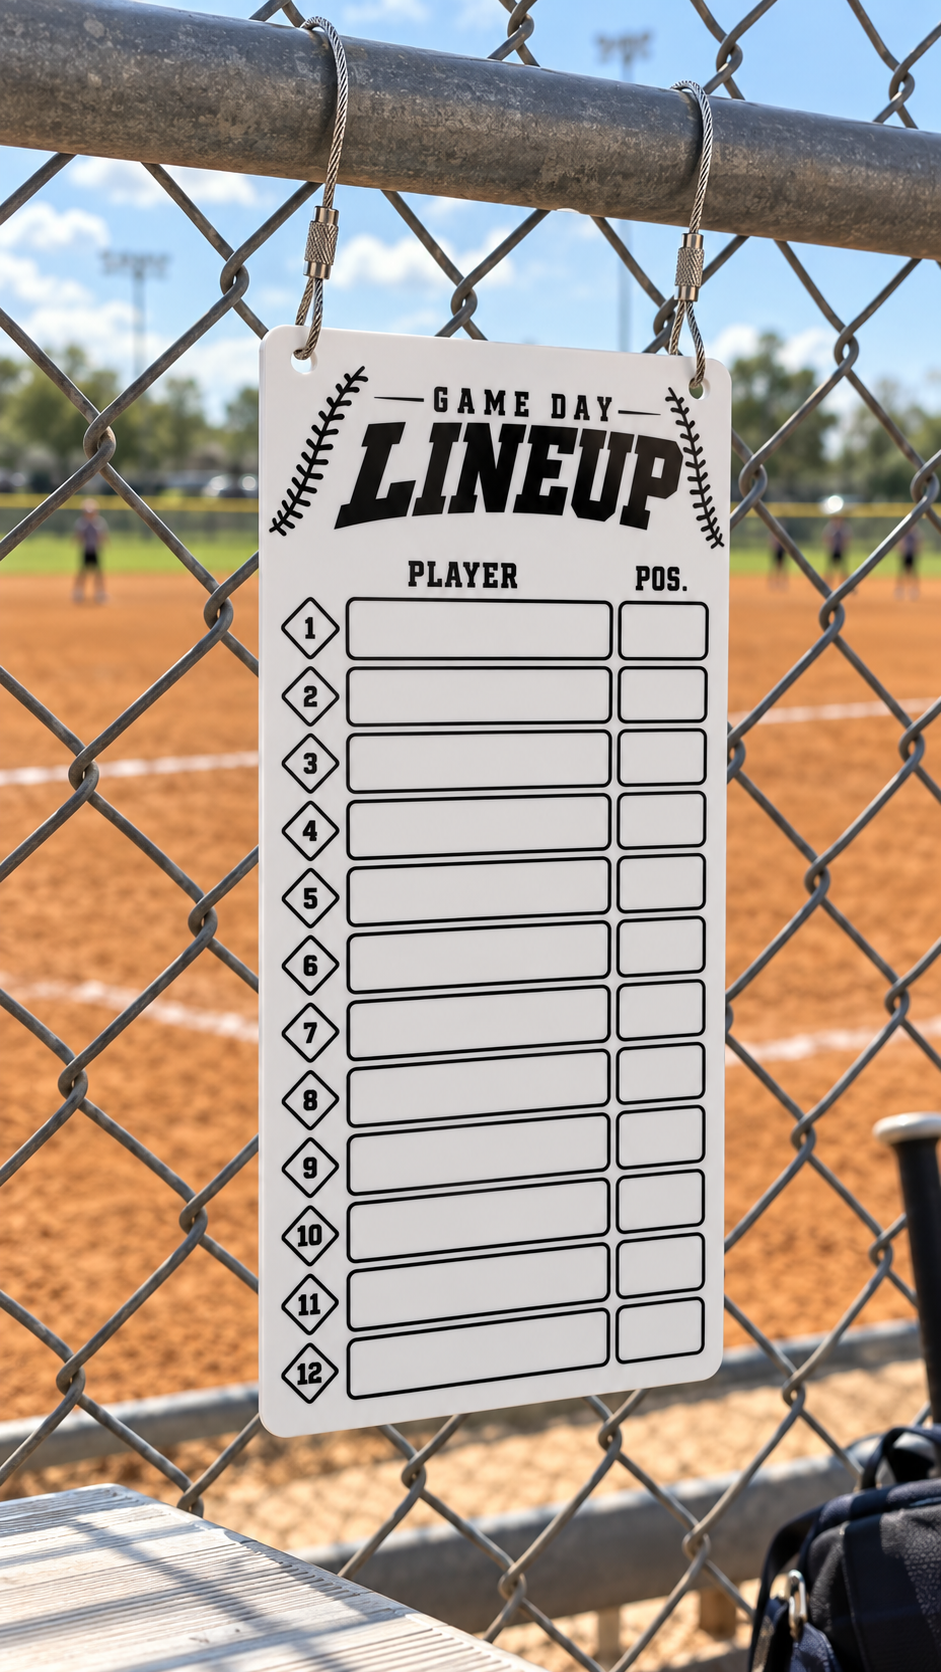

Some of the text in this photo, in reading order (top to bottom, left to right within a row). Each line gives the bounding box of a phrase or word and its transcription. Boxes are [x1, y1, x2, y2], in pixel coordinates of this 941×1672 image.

[433, 386, 613, 422] GAME DAY
[334, 422, 684, 531] LINEUP
[407, 560, 518, 589] PLAYER
[635, 565, 688, 592] POS.
[304, 616, 316, 640] 1
[303, 685, 318, 708] 2
[303, 752, 318, 775] 3
[302, 819, 318, 842] 4
[303, 887, 318, 910] 5
[303, 954, 318, 977] 6
[303, 1021, 318, 1044] 7
[302, 1089, 318, 1112] 8
[302, 1156, 318, 1180] 9
[297, 1223, 323, 1248] 10
[298, 1292, 321, 1317] 11
[296, 1361, 323, 1386] 12
